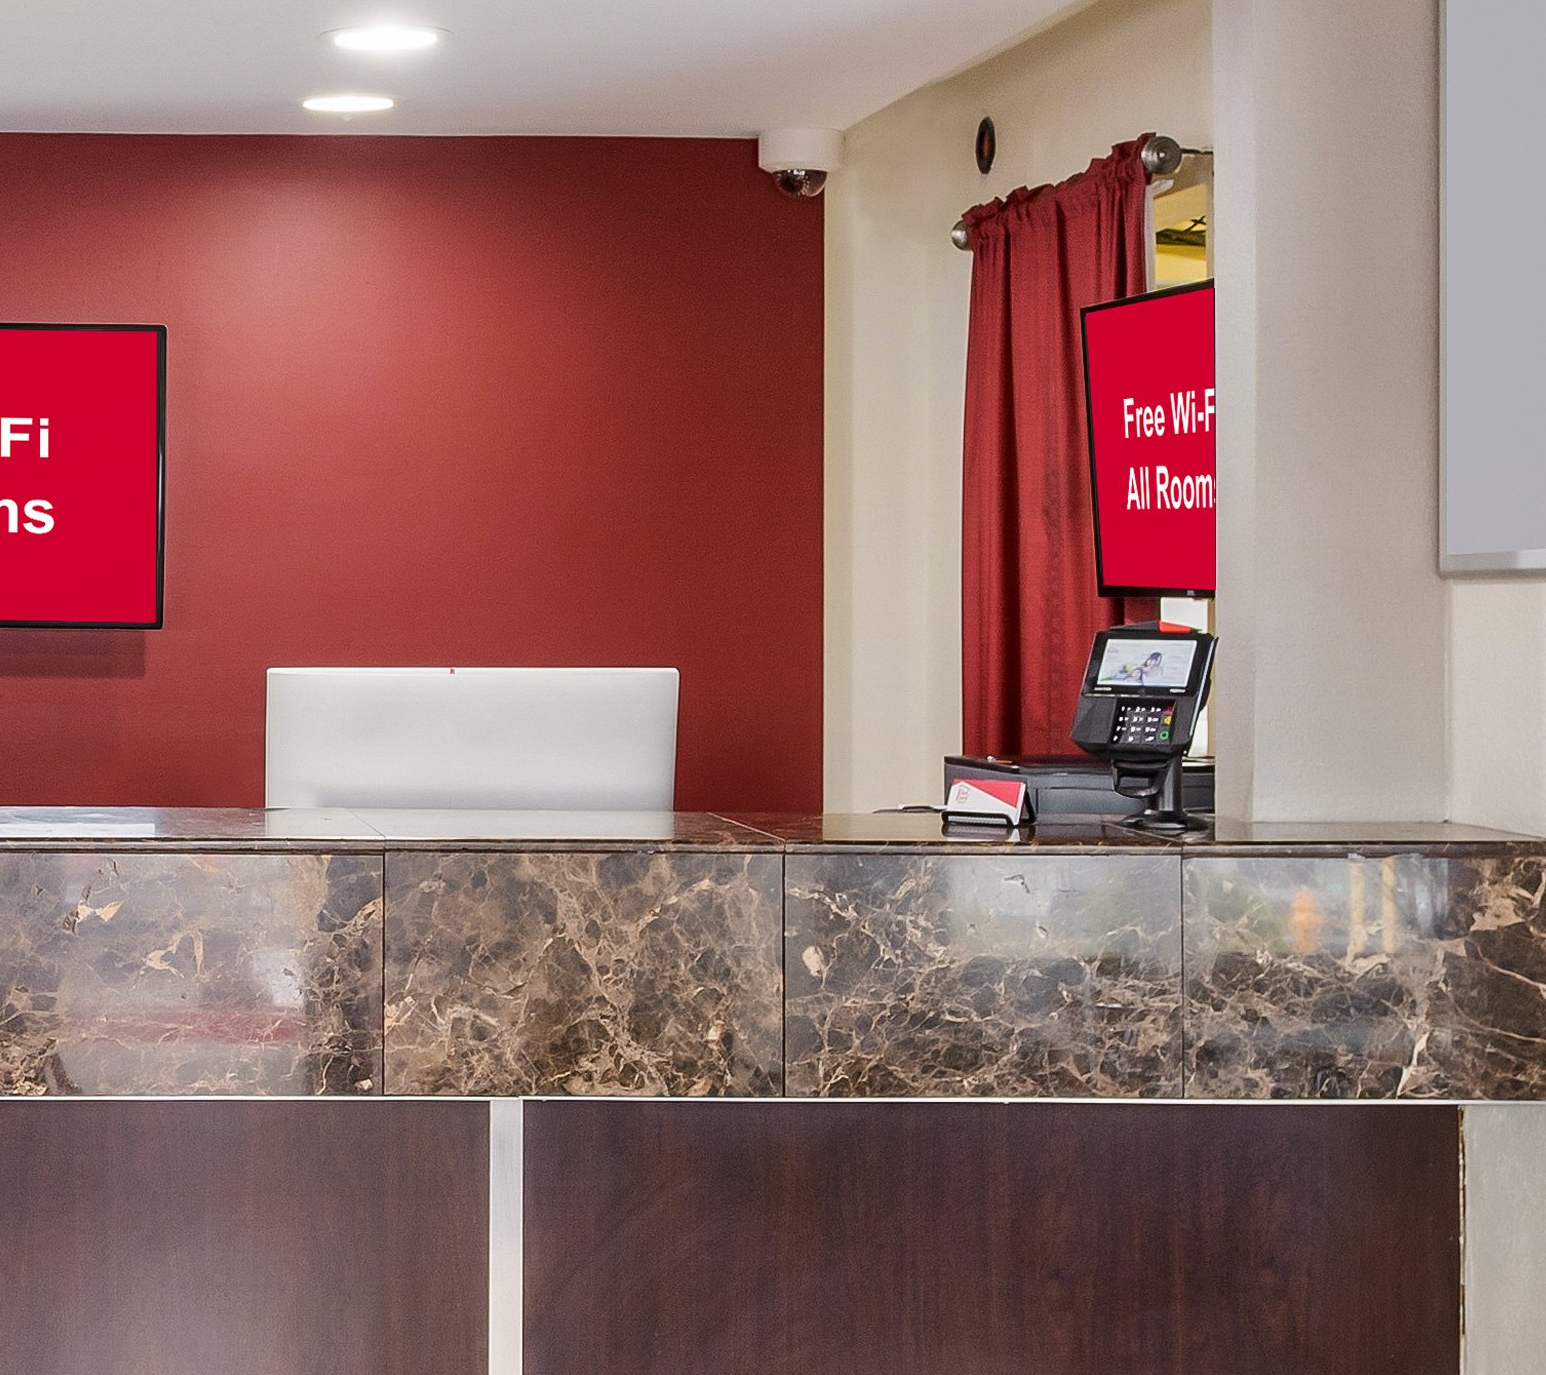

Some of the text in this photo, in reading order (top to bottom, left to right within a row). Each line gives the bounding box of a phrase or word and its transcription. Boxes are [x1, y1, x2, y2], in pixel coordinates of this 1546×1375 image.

[1123, 388, 1215, 438] Free Wi-F
[1126, 465, 1215, 510] All Room
